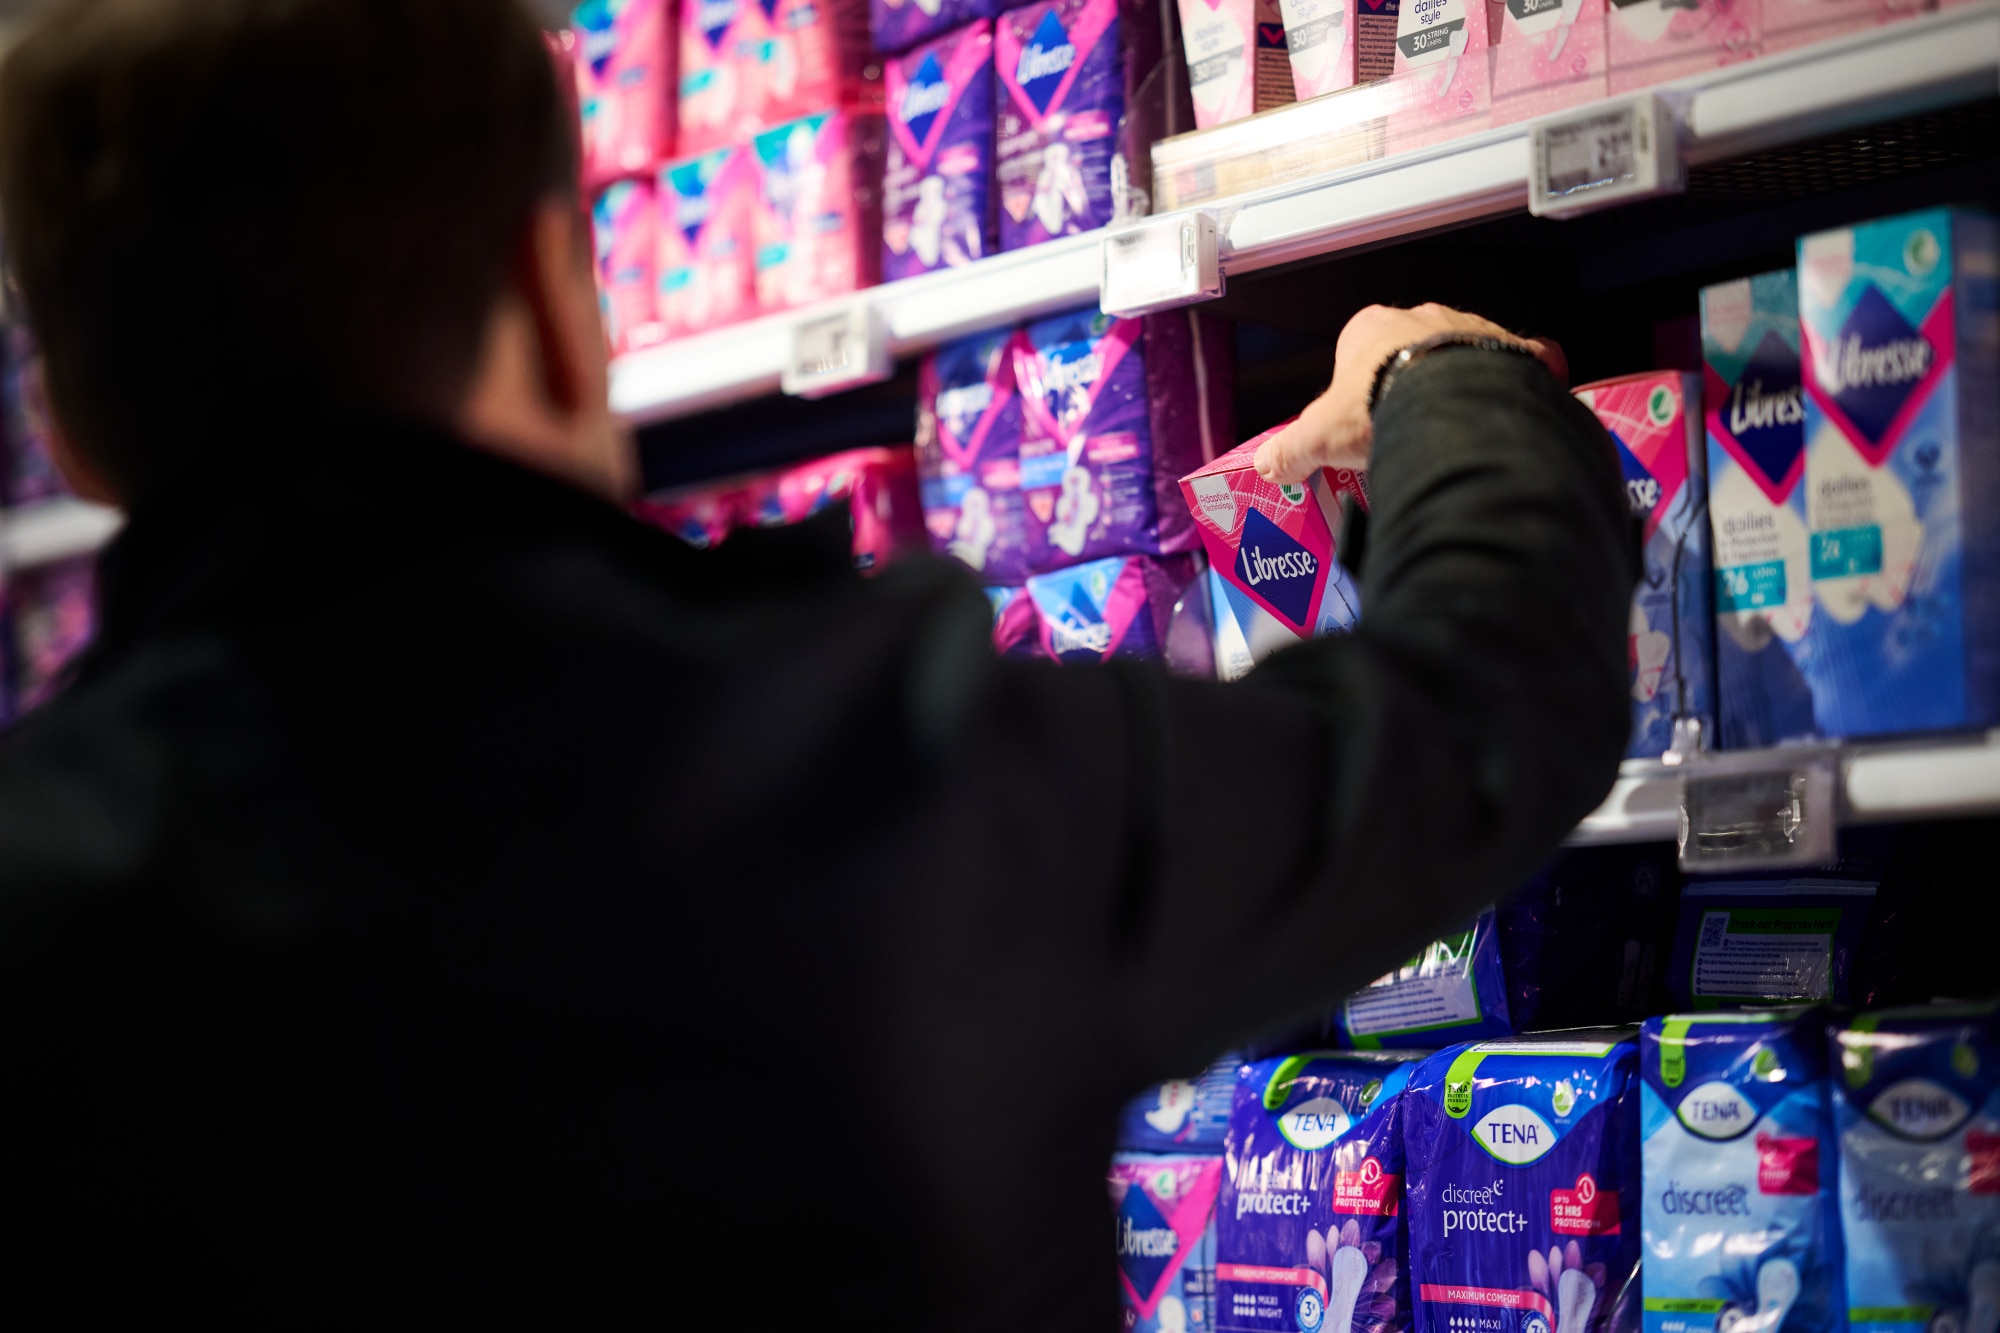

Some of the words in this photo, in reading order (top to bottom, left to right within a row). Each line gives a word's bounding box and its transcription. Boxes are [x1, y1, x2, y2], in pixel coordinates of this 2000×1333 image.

[1420, 9, 1441, 25] style
[1292, 29, 1307, 49] 30
[1427, 27, 1449, 40] STRING
[1413, 33, 1427, 52] 30
[1731, 380, 1804, 436] Libres
[1200, 491, 1230, 504] Adaptive
[1203, 502, 1235, 512] Technology
[1241, 546, 1316, 586] Libresse
[1731, 919, 1755, 929] Track
[1757, 921, 1772, 929] our
[1773, 919, 1812, 930] Progress
[1813, 919, 1834, 929] Here
[1691, 1101, 1741, 1121] TENA
[1294, 1113, 1336, 1132] TENA
[1488, 1122, 1538, 1145] TENA
[1336, 1186, 1345, 1197] 12
[1346, 1186, 1364, 1197] HRS
[1442, 1182, 1494, 1206] discreet
[1661, 1180, 1752, 1216] discreet
[1236, 1192, 1312, 1221] protect+
[1335, 1197, 1381, 1209] PROTECTION
[1562, 1196, 1570, 1205] TO
[1553, 1204, 1563, 1216] 12
[1564, 1205, 1582, 1217] HRS
[1443, 1208, 1529, 1238] protect+
[1554, 1217, 1601, 1229] PROTECTION
[1116, 1215, 1178, 1258] Libresse
[1257, 1295, 1279, 1306] MAXI
[1448, 1289, 1485, 1300] MAXIMUM
[1486, 1292, 1521, 1305] COMFORT
[1257, 1307, 1283, 1319] NIGHT
[1479, 1318, 1501, 1330] MAXI
[1522, 1316, 1531, 1330] DRY
